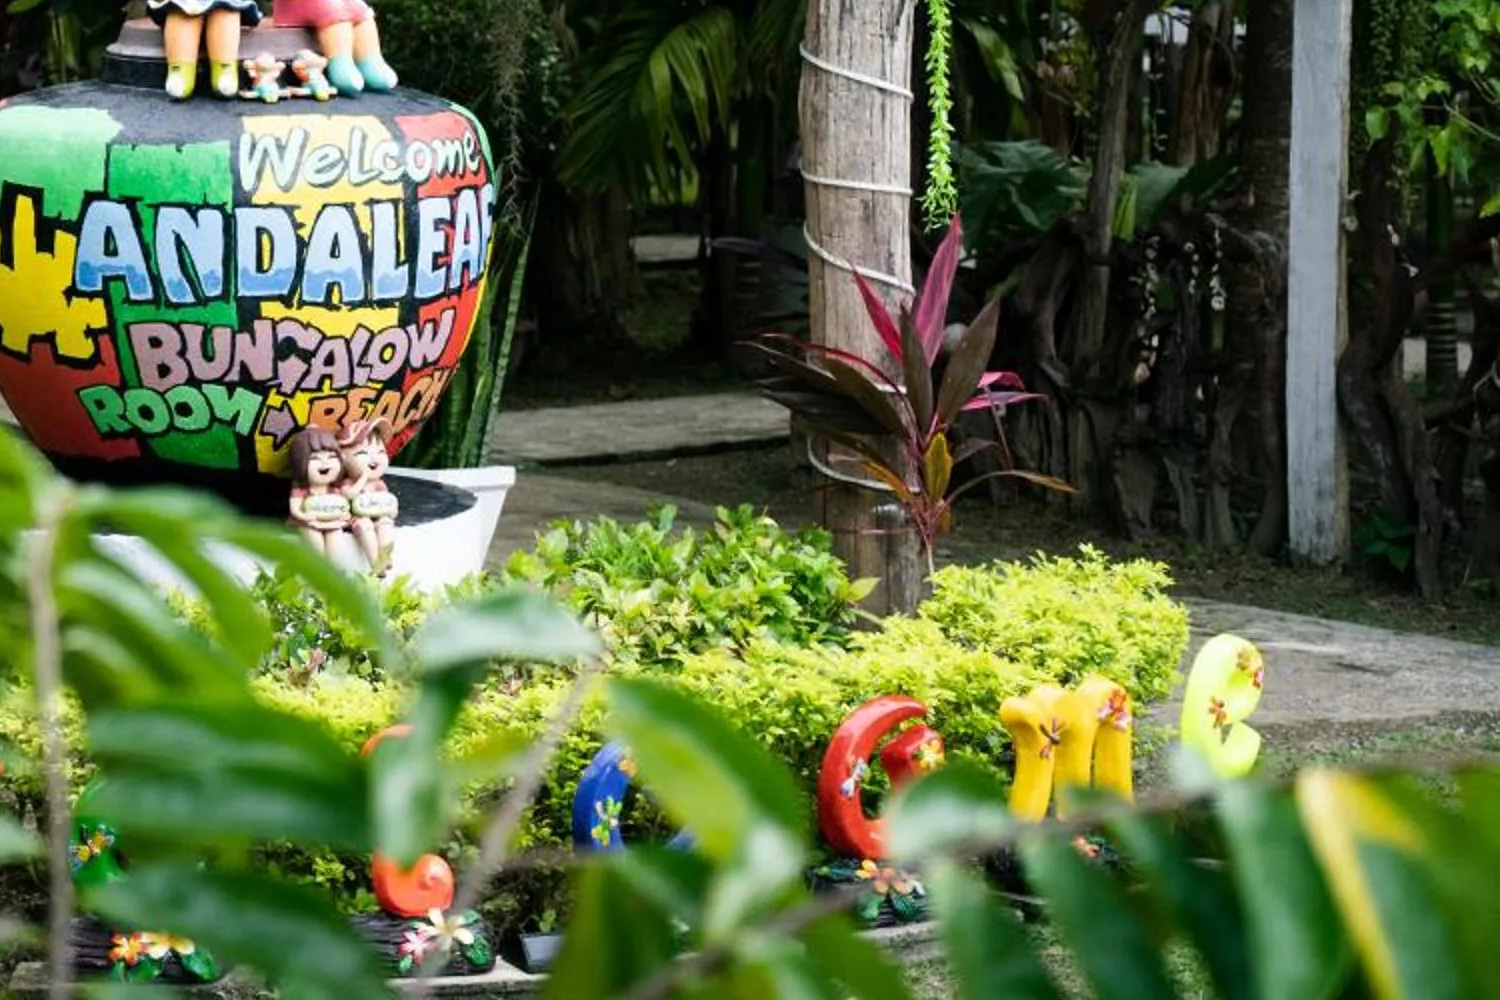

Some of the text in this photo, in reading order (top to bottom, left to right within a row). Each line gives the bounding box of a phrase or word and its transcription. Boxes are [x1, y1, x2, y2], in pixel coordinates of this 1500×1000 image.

[239, 125, 482, 191] Welcome
[127, 308, 456, 395] BUNGALOW
[77, 384, 264, 438] ROOM
